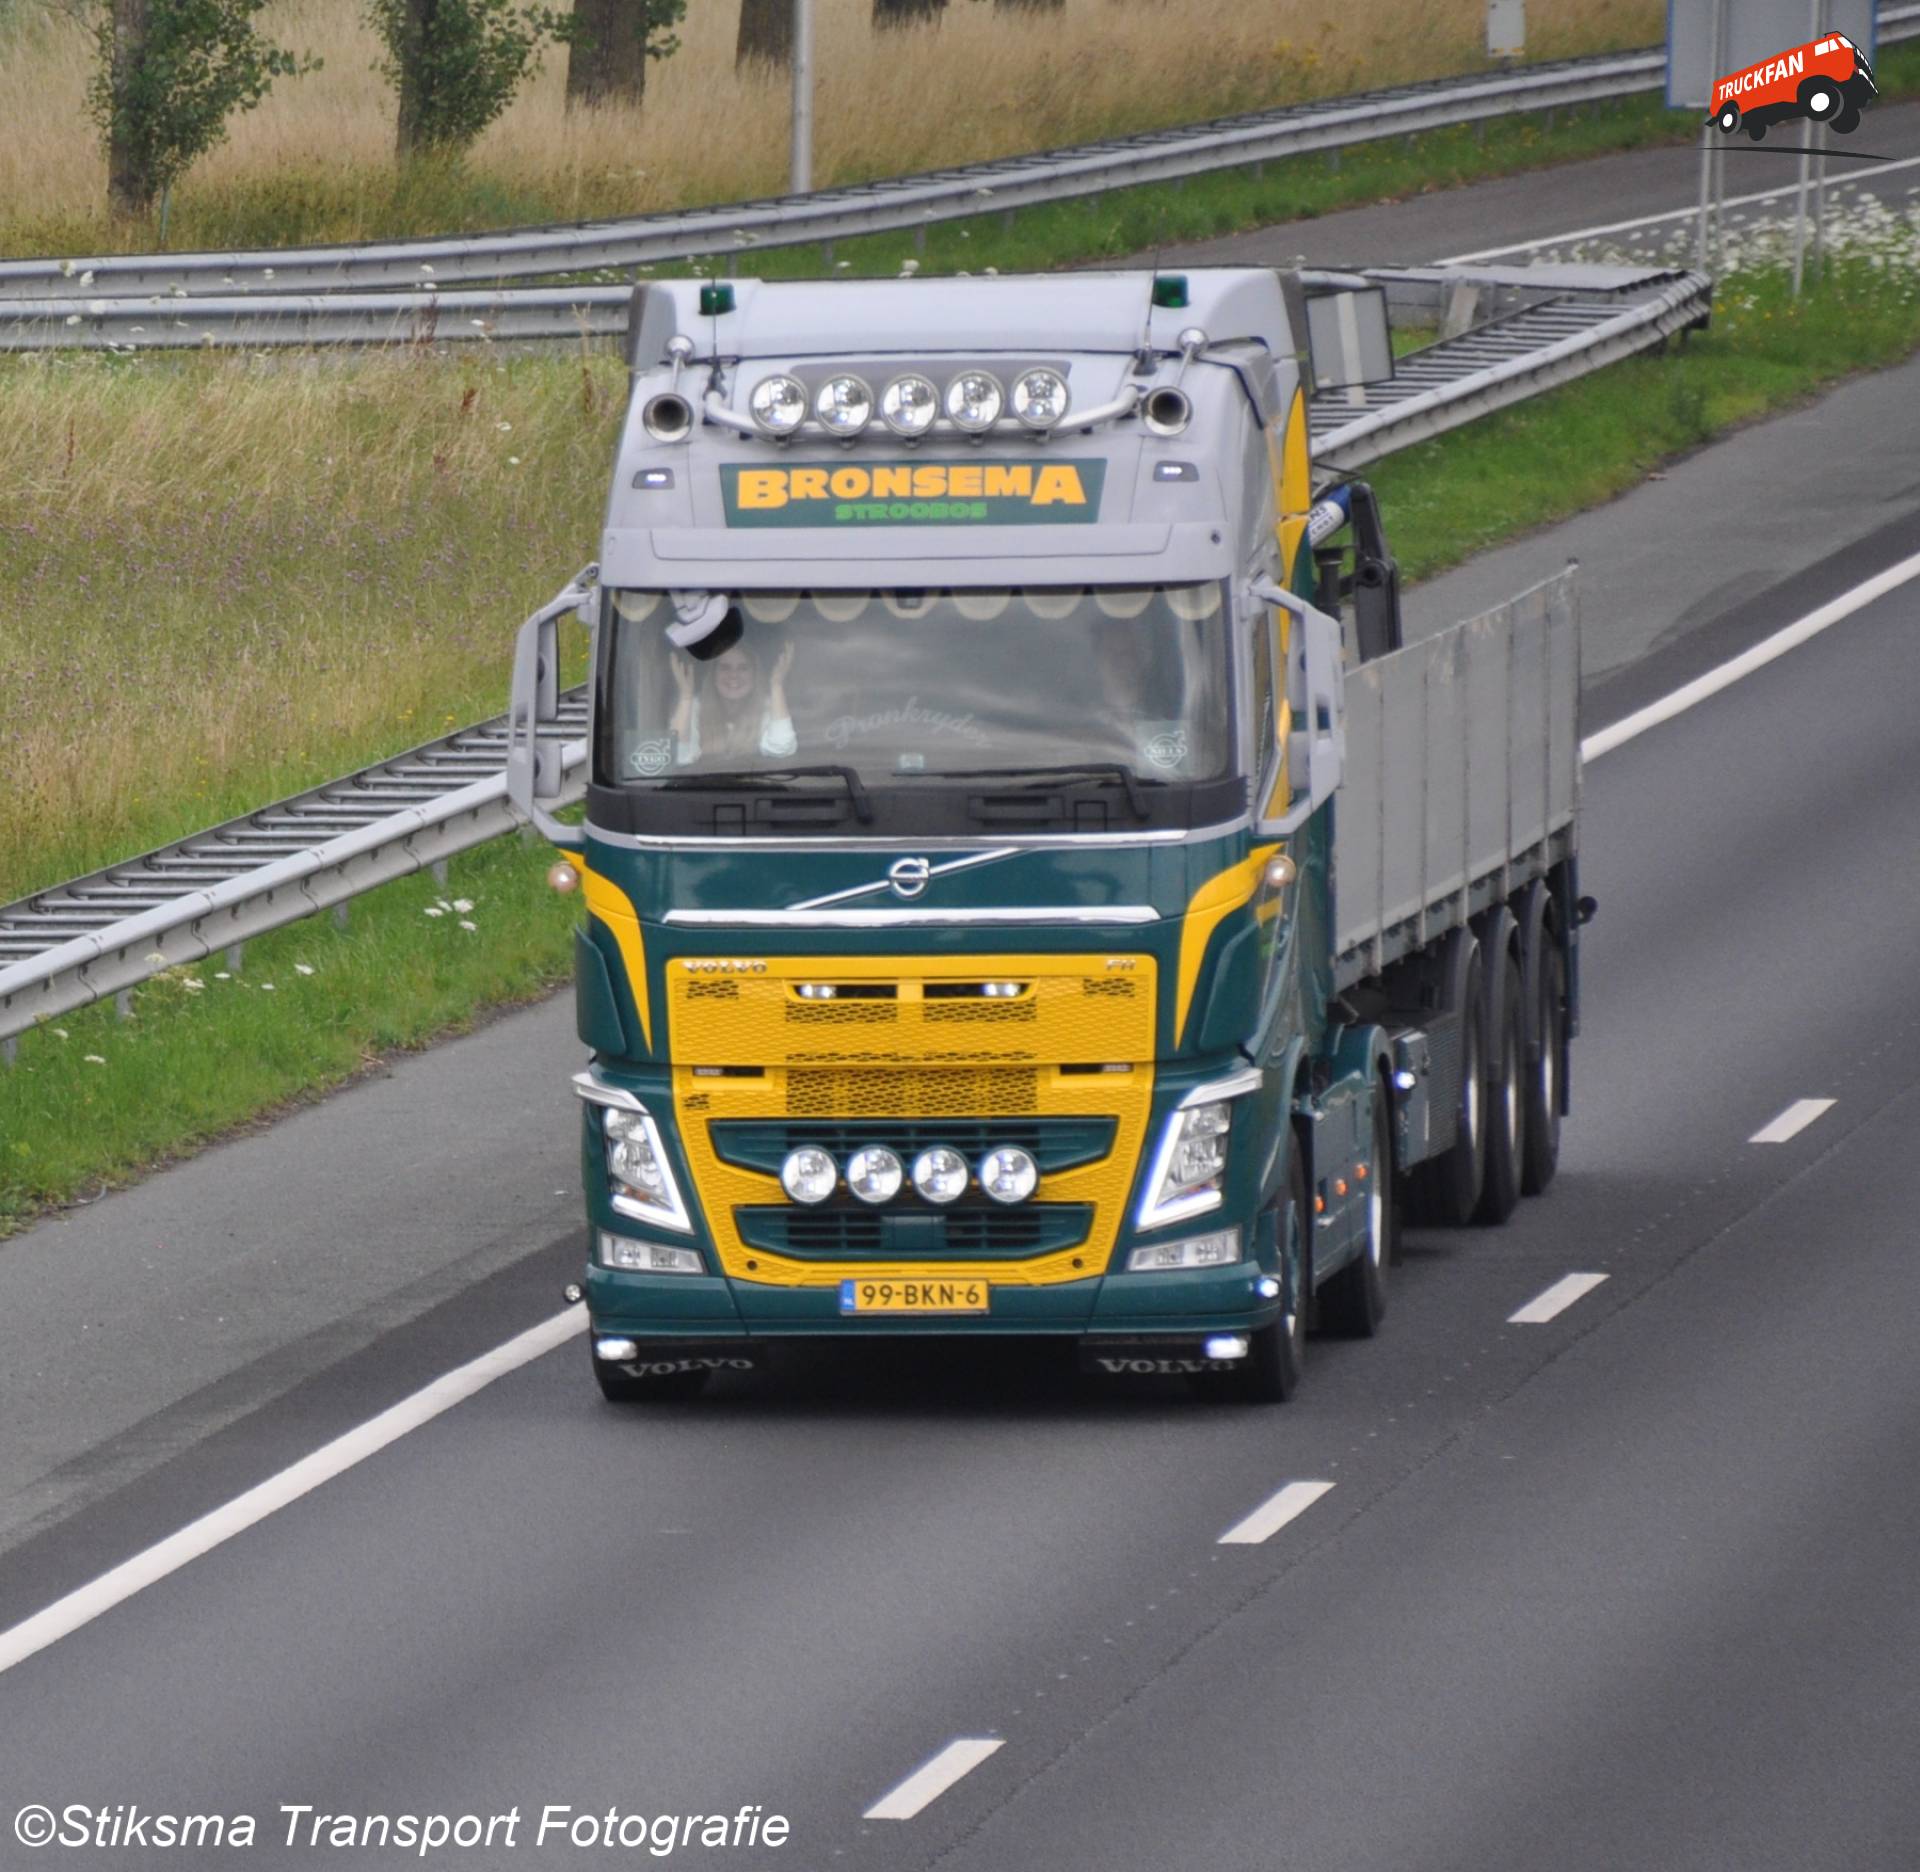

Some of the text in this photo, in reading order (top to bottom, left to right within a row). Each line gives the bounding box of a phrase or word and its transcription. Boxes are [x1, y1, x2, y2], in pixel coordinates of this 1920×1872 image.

[737, 465, 1087, 509] BRONSEMA
[682, 960, 767, 974] VOLVO
[862, 1284, 980, 1306] 99-BKN-6
[619, 1358, 754, 1377] VOLVO
[1097, 1358, 1236, 1373] VOLVO
